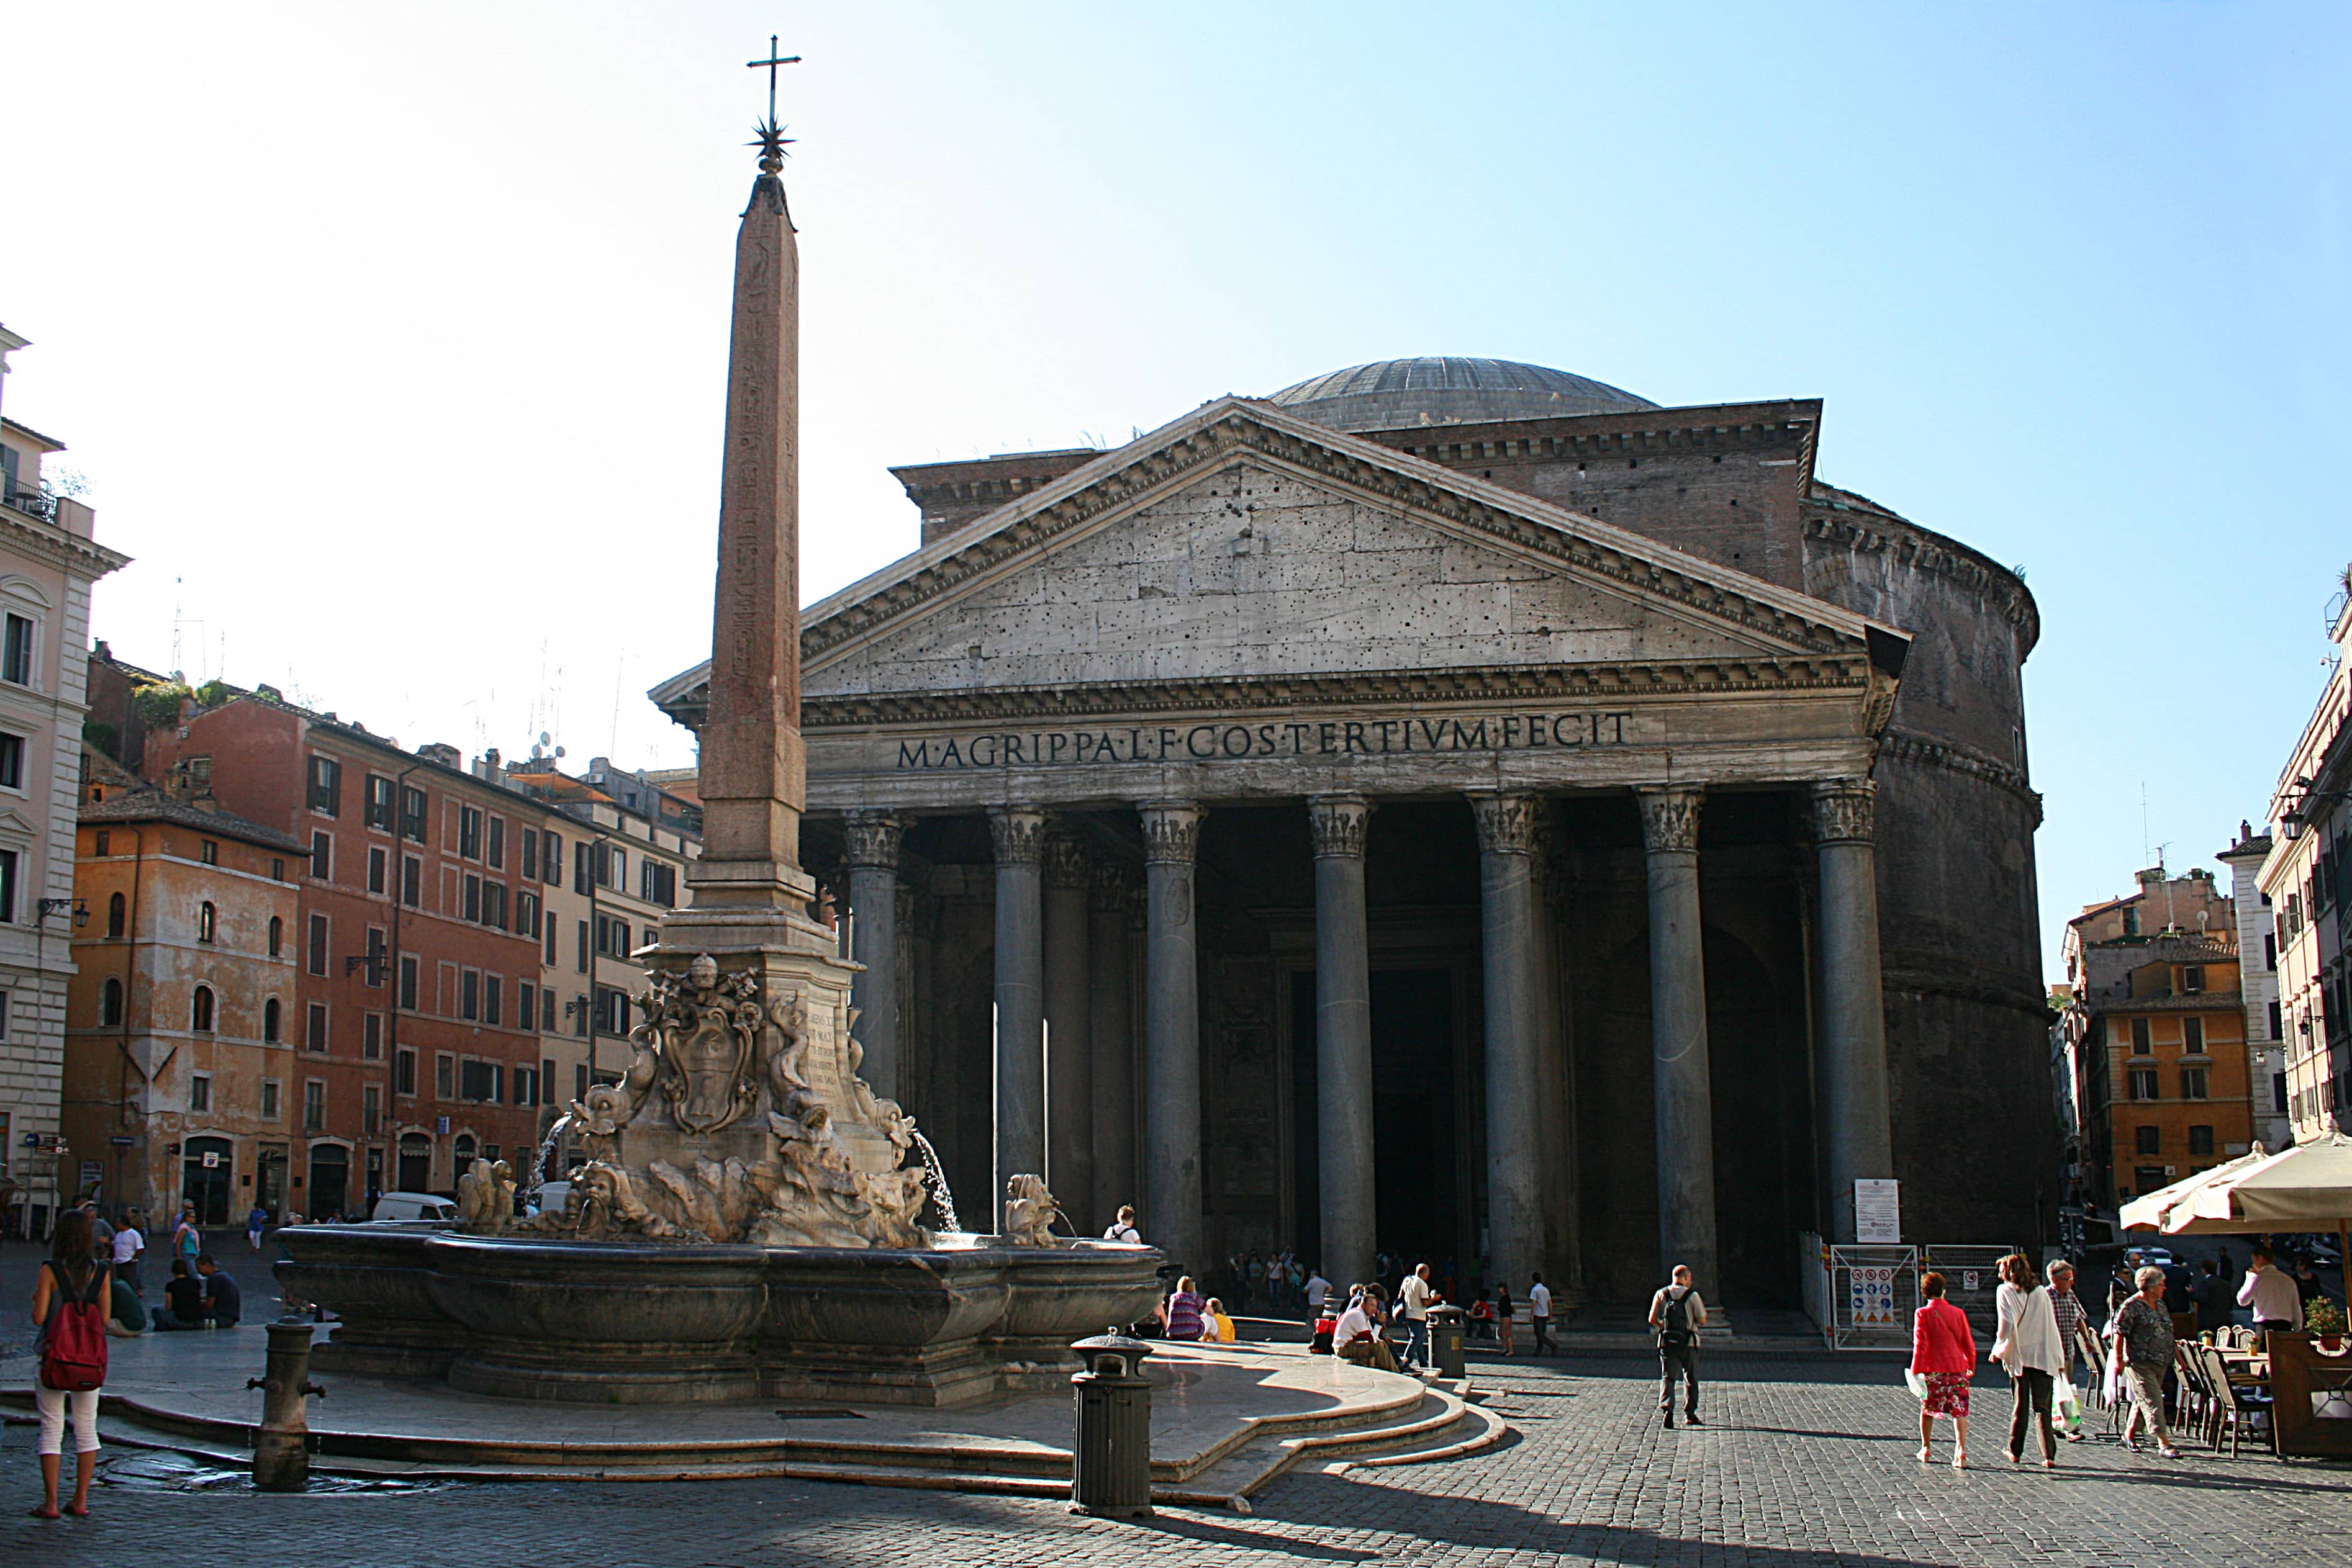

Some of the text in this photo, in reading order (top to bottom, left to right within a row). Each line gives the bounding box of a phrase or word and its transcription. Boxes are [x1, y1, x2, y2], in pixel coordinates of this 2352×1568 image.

[937, 731, 1121, 768] AGRIPPA
[1187, 725, 1276, 759] COS
[1284, 718, 1490, 755] TERTIVM
[1501, 713, 1632, 749] FECIT
